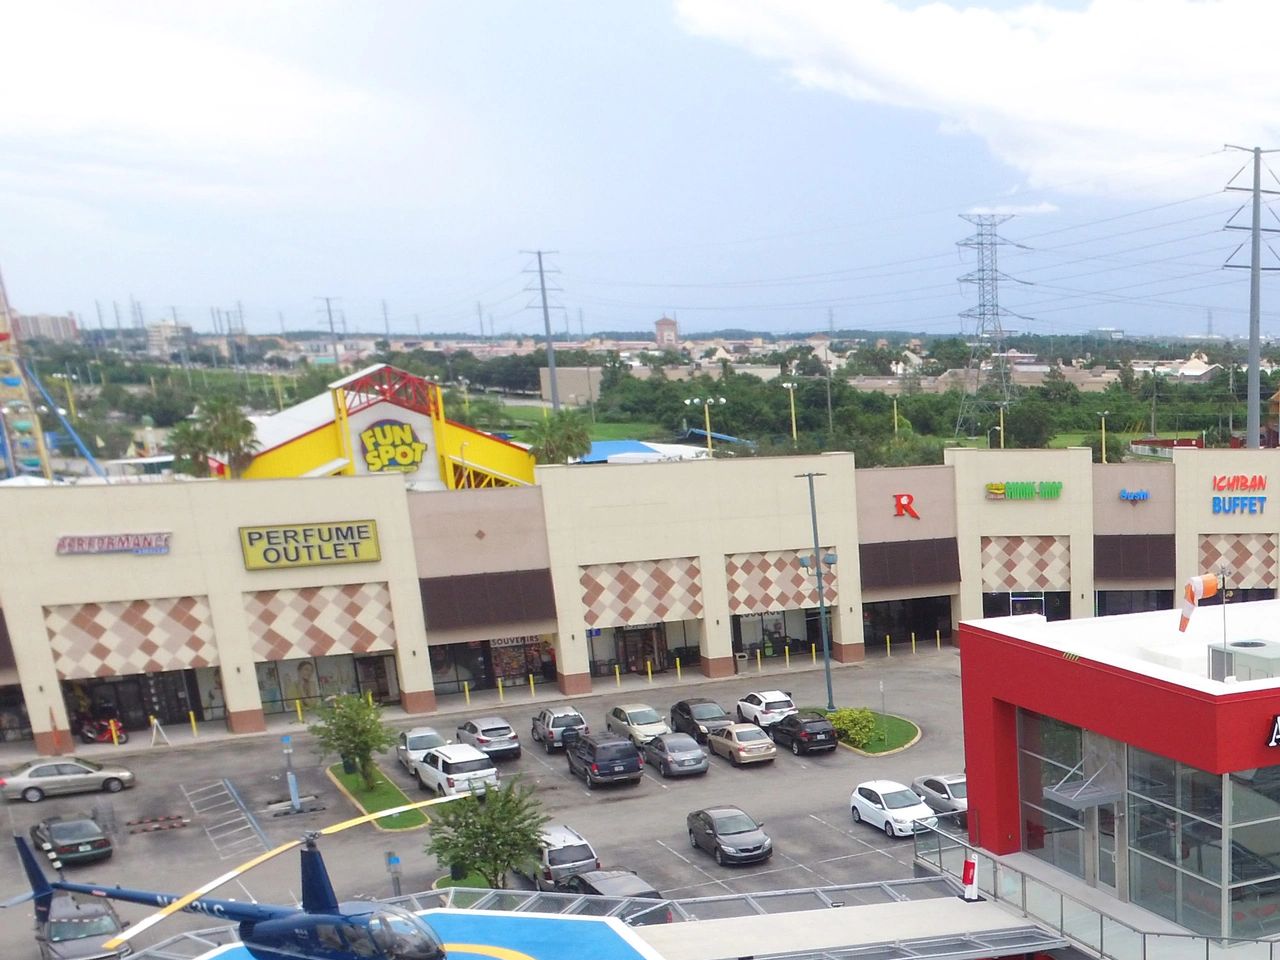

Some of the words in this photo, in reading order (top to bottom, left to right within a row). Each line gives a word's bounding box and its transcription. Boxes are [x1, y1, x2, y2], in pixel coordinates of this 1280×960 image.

[361, 424, 413, 451] FUN
[365, 442, 426, 472] SPOT
[1212, 474, 1267, 492] ICHIBAN
[1212, 496, 1267, 514] BUFFET
[247, 525, 370, 546] PERFUME
[263, 542, 360, 563] OUTLET
